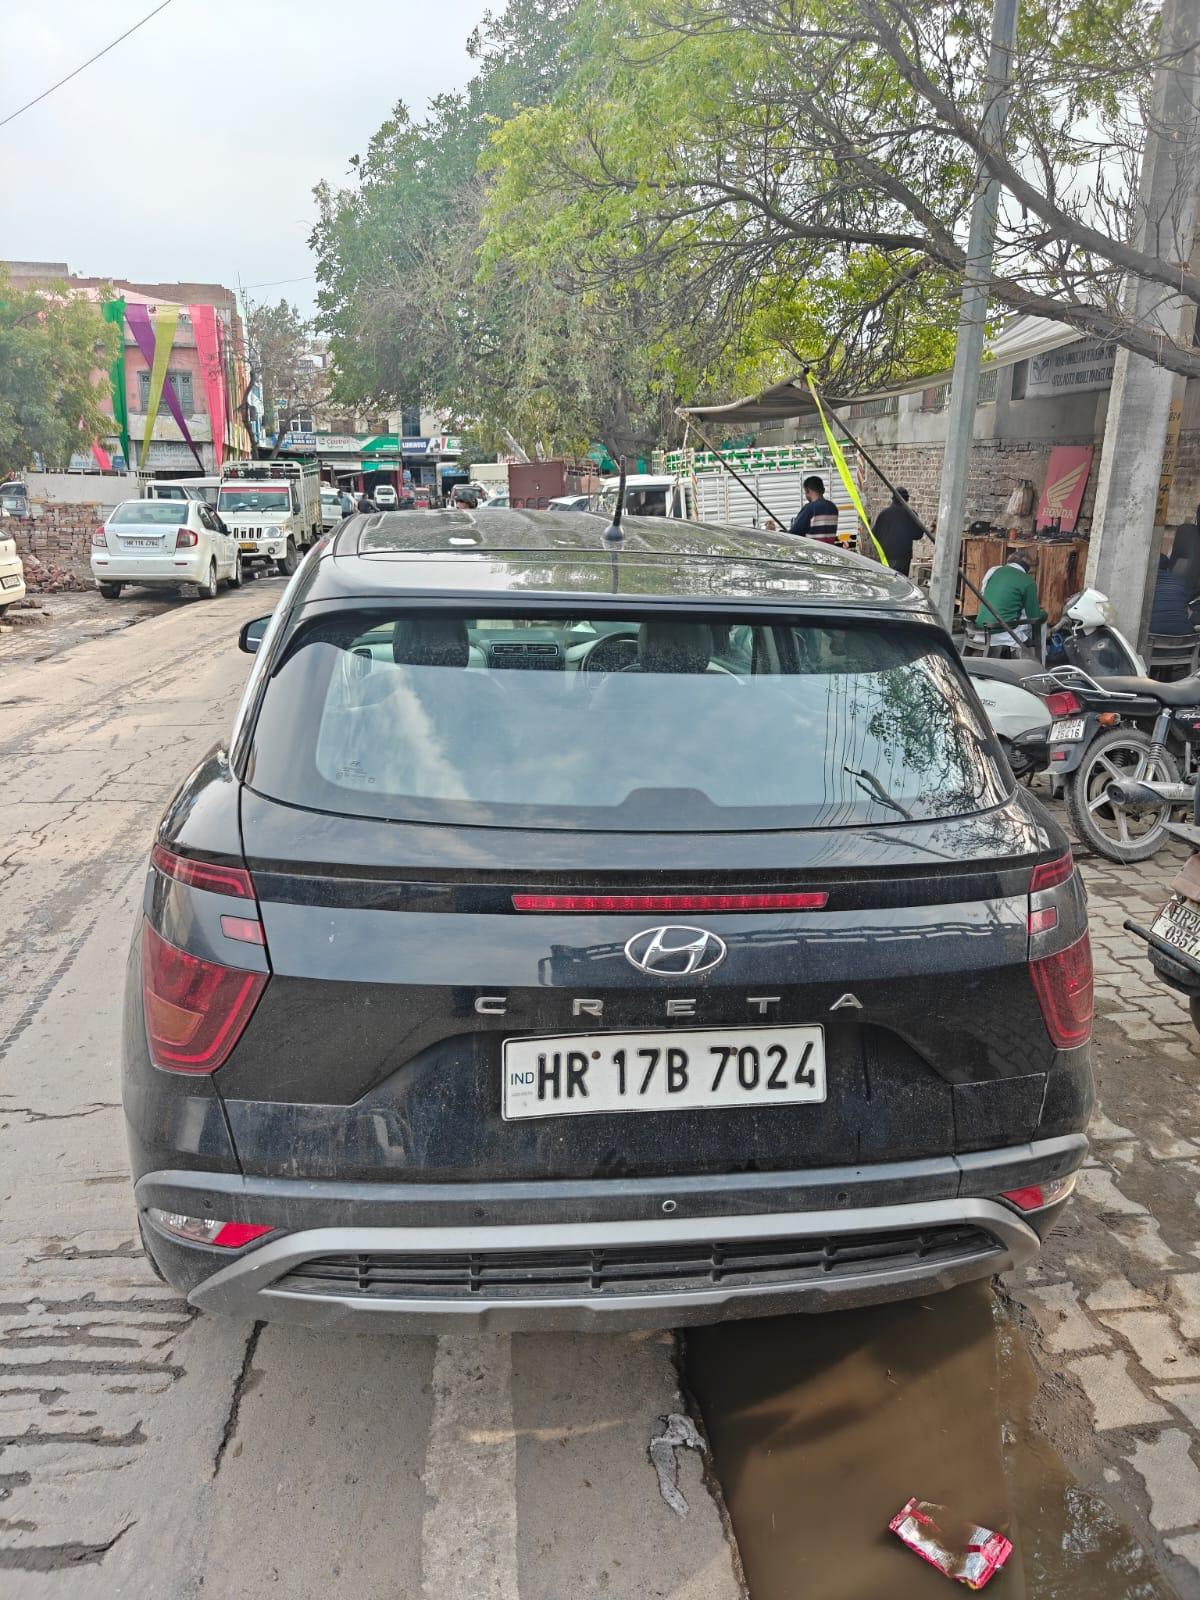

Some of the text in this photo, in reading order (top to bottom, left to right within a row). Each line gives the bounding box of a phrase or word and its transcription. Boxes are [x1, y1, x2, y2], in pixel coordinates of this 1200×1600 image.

[402, 441, 427, 449] LUMINOUS
[1041, 507, 1073, 519] HONDA
[474, 993, 864, 1017] CRETA
[537, 1041, 817, 1100] HR 17B 7024
[510, 1071, 535, 1086] IND
